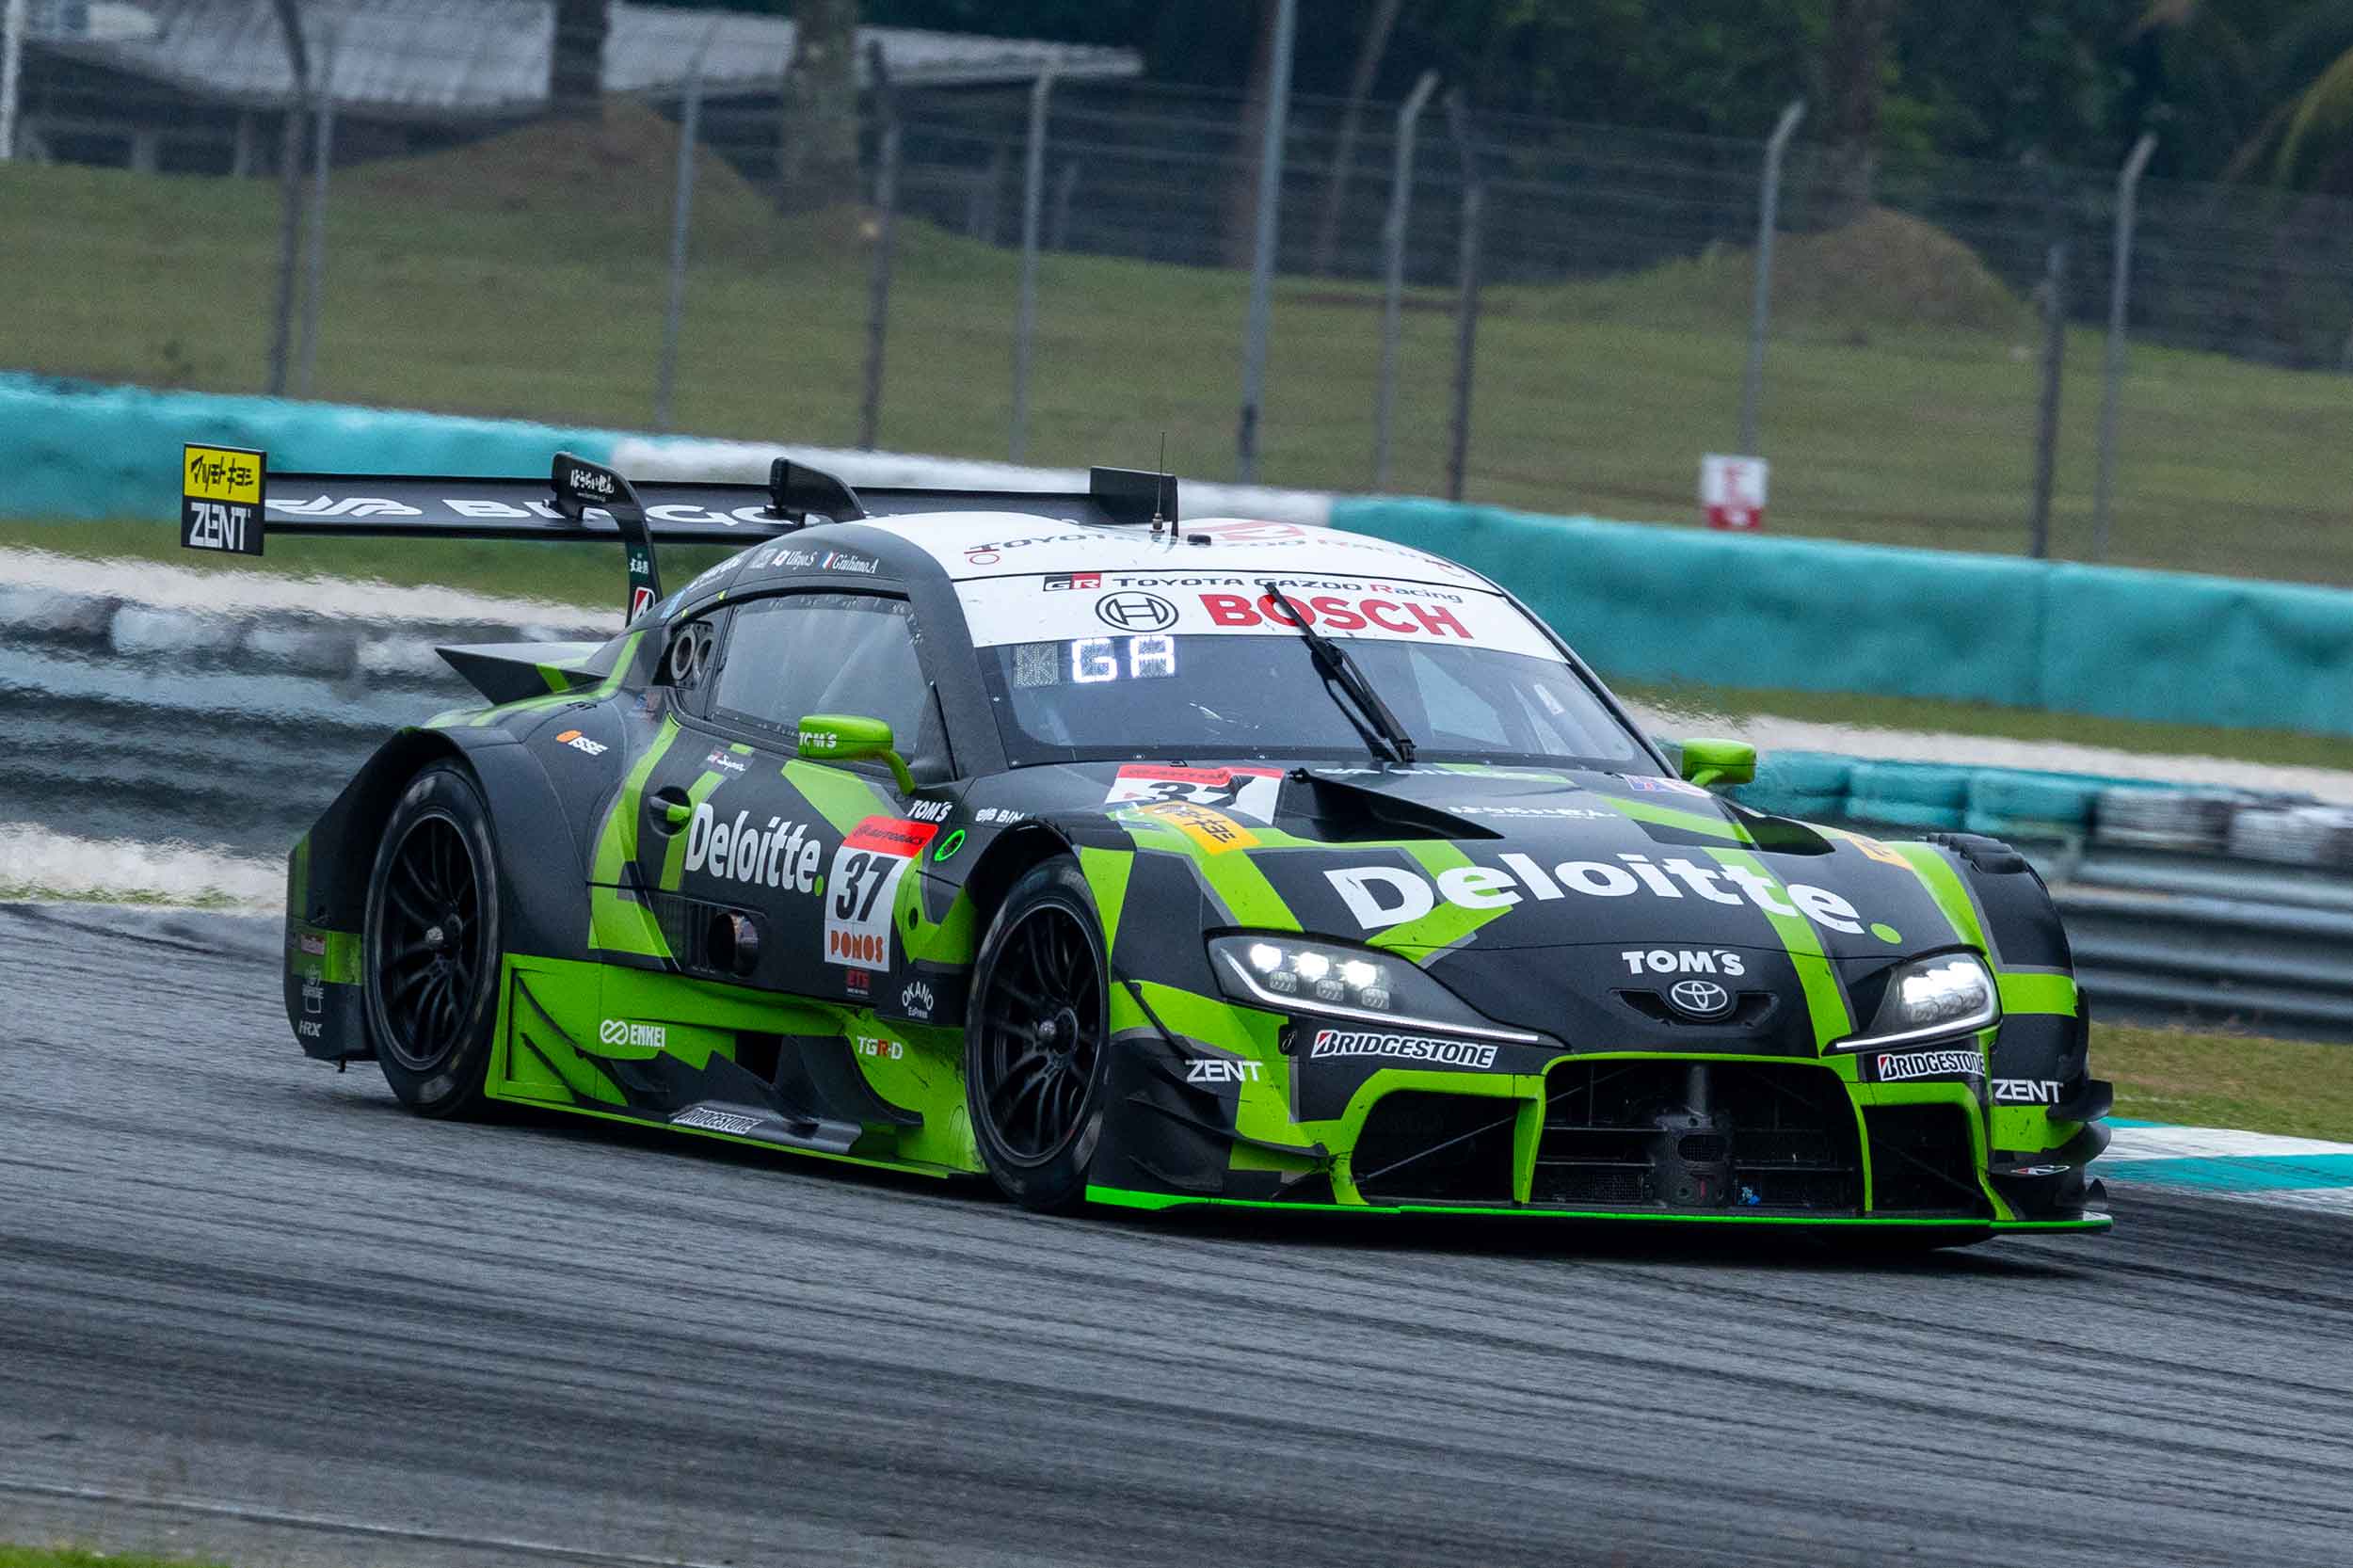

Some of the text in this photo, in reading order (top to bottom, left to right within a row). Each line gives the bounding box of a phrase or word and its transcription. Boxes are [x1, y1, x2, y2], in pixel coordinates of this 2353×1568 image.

[189, 502, 250, 551] ZENT
[1045, 575, 1101, 591] GR
[1112, 578, 1464, 603] TOYOTA GAZOO Racing
[1198, 594, 1474, 639] BOSCH
[1148, 775, 1257, 808] 37
[906, 800, 952, 823] TOM'S
[836, 852, 900, 921] 37
[1322, 852, 1902, 945] Deloitte.
[830, 930, 884, 964] PONOS
[1622, 949, 1745, 976] TOM'S
[902, 981, 934, 1011] OKANO
[630, 1024, 665, 1048] ENKEI
[1312, 1030, 1497, 1068] BRIDGESTONE
[1186, 1060, 1263, 1081] ZENT
[1878, 1051, 1985, 1080] BRIDGESTONE
[1993, 1079, 2063, 1103] ZENT
